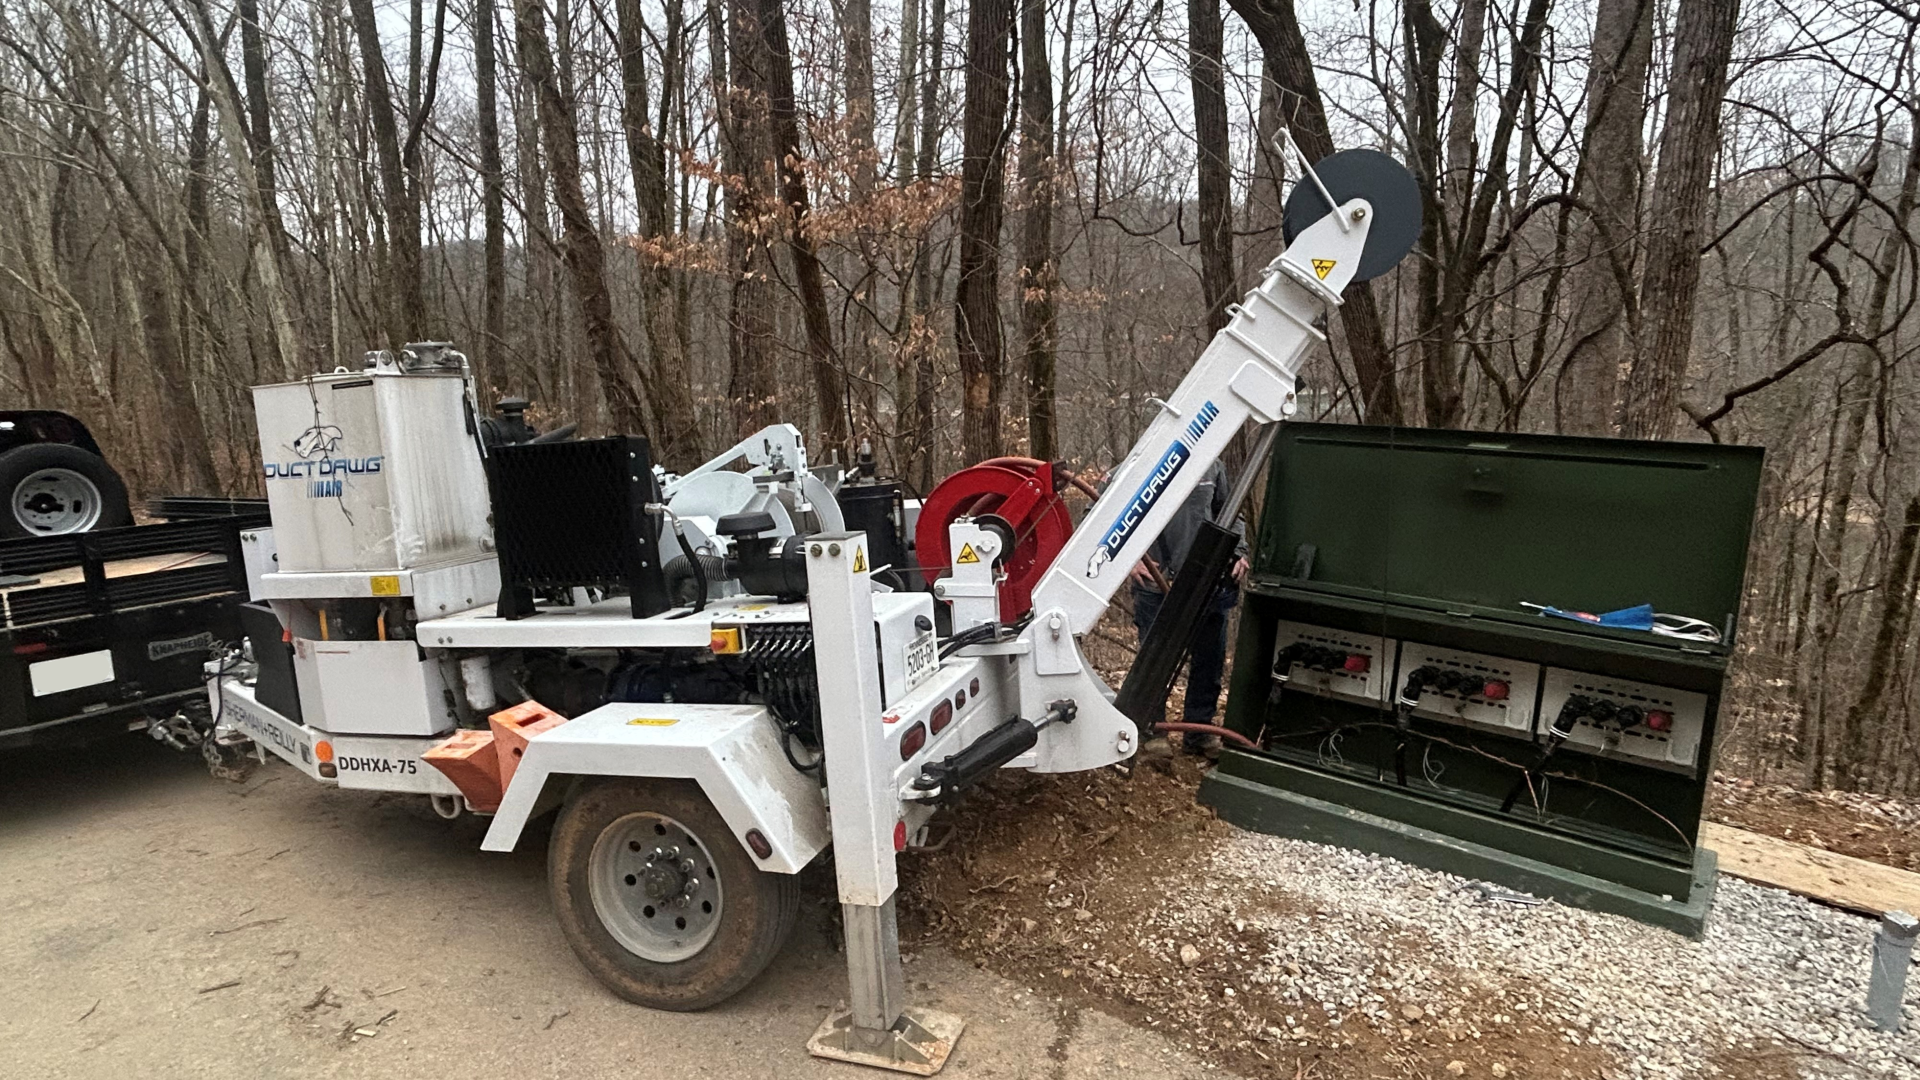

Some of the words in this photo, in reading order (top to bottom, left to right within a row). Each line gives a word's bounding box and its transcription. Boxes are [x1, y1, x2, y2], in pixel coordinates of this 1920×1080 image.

[1197, 400, 1220, 430] AIR
[264, 461, 316, 479] DUCT
[320, 457, 381, 476] DAWG
[325, 480, 343, 498] AIR
[1108, 500, 1143, 549] DUCT
[1140, 451, 1182, 504] DAWG
[338, 756, 417, 775] DDHXA-75
